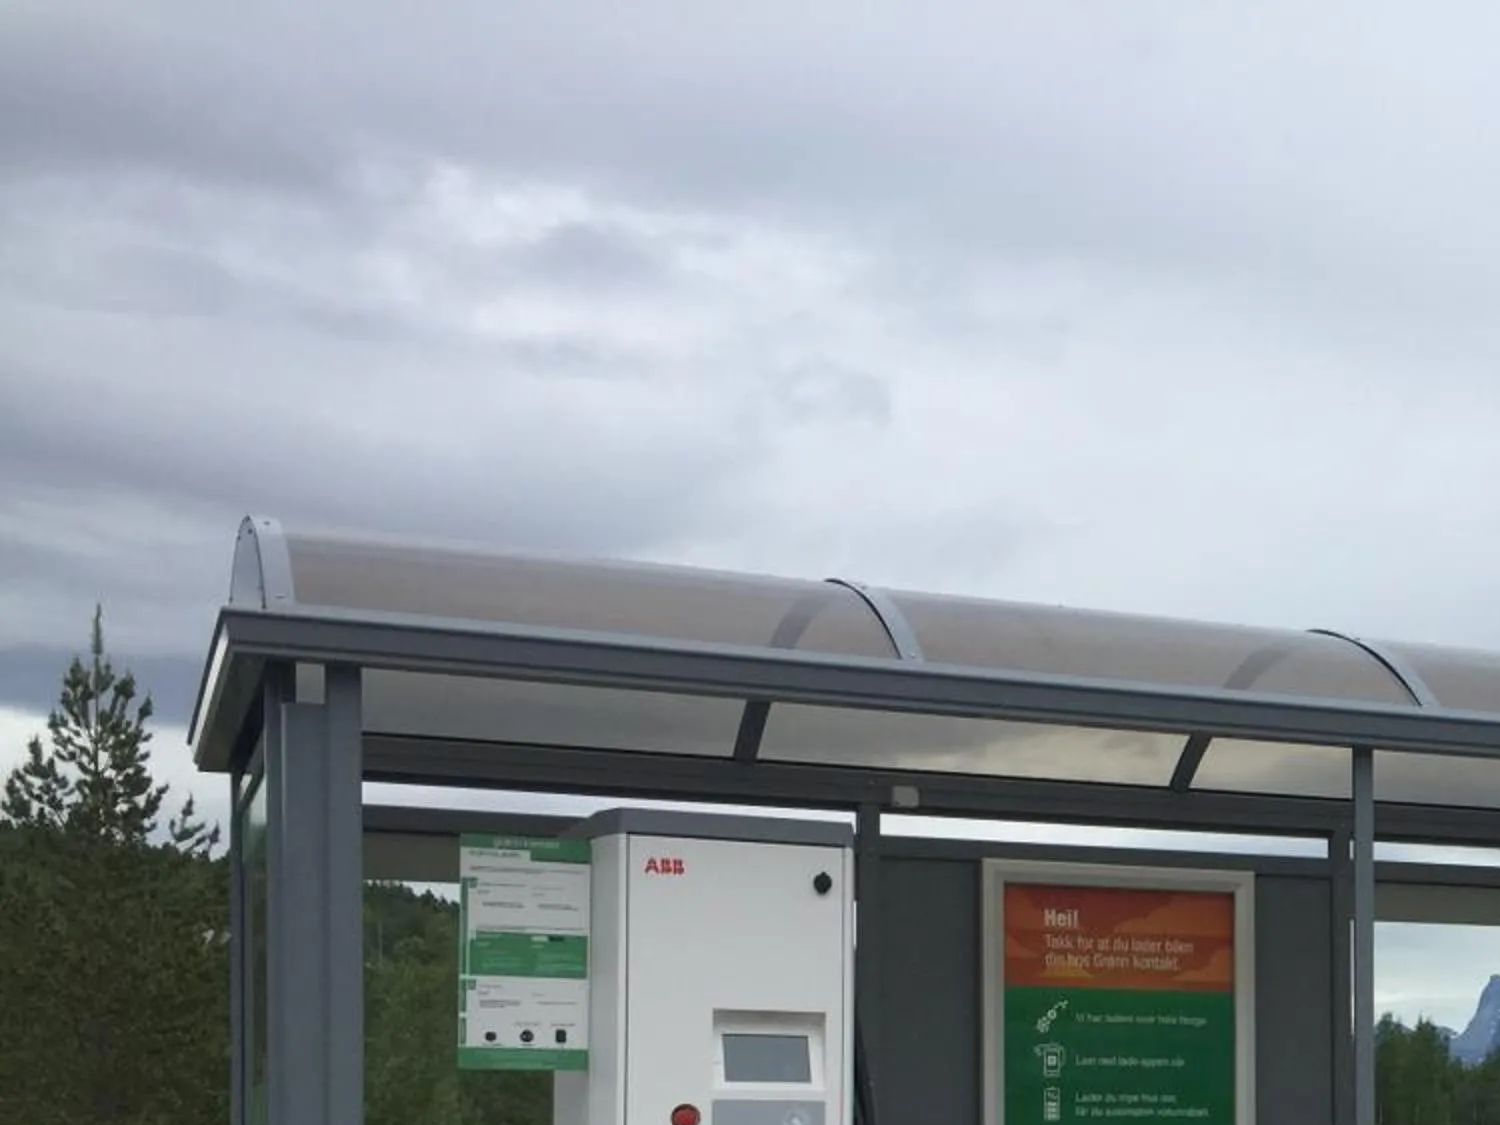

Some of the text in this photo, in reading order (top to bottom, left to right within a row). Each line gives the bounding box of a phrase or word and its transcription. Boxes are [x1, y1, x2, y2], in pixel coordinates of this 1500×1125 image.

[644, 856, 685, 875] ABB
[1043, 908, 1079, 928] Hei!
[1045, 932, 1073, 950] Takk
[1097, 937, 1109, 951] at
[1113, 936, 1129, 952] du
